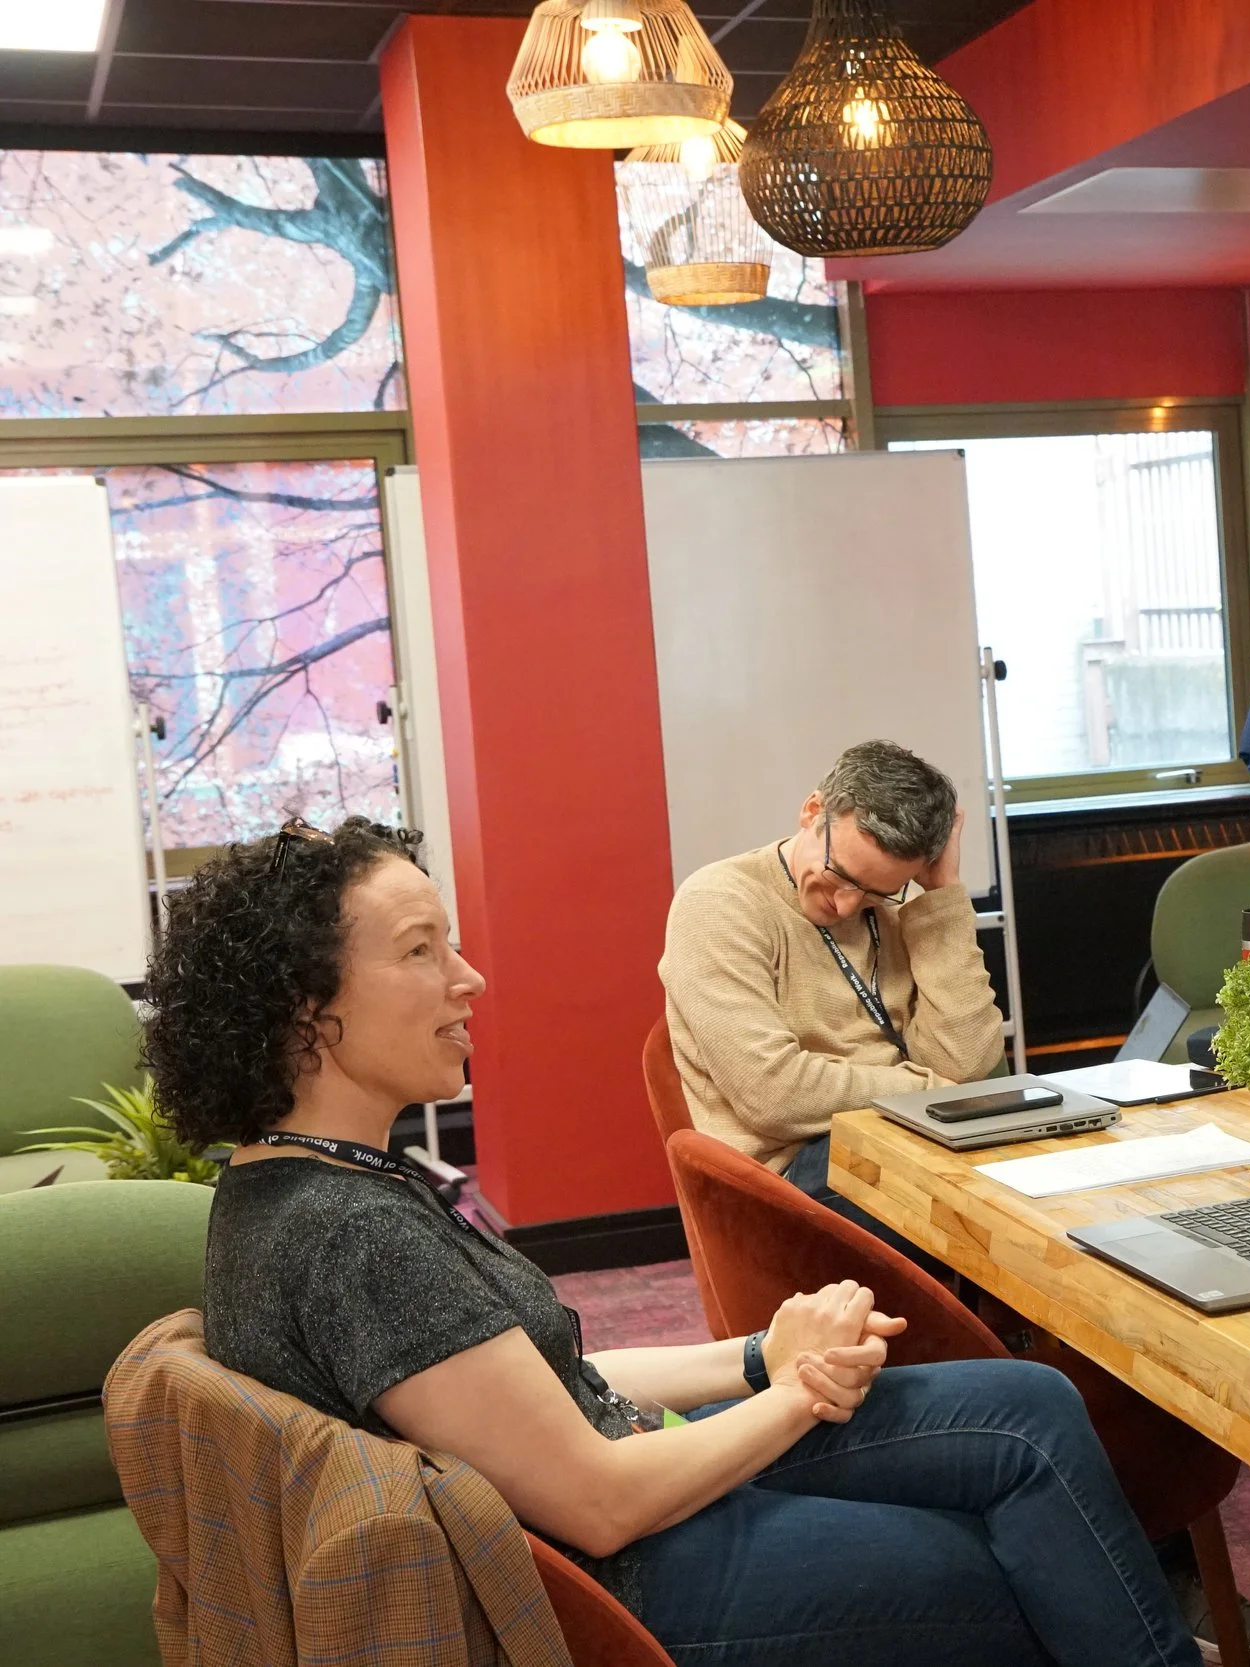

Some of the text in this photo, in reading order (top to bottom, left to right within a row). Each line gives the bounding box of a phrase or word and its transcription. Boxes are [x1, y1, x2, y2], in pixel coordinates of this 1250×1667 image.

[860, 990, 868, 998] of
[865, 998, 885, 1025] Republic
[268, 1135, 279, 1145] of
[282, 1135, 338, 1153] Republic
[352, 1149, 383, 1168] Work.
[384, 1161, 397, 1169] of
